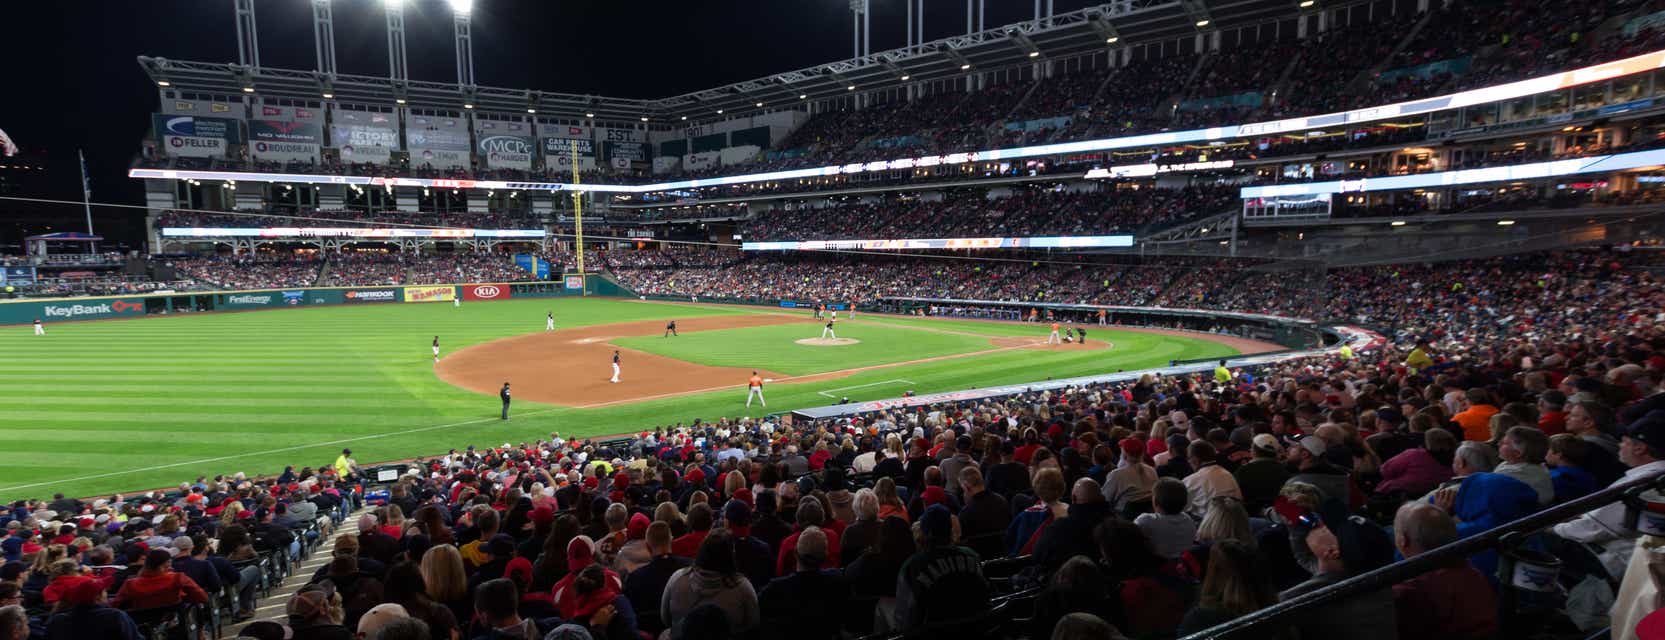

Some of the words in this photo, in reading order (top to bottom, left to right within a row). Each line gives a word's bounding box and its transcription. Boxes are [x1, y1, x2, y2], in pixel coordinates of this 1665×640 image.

[607, 129, 636, 141] EST.
[185, 138, 220, 148] FELLER
[566, 139, 590, 147] PRTS
[269, 144, 314, 153] BOUDREAU
[547, 144, 592, 152] WAREHUSE
[478, 288, 495, 296] KIA
[229, 295, 271, 304] FirstEnergy
[45, 303, 111, 317] KeyBank
